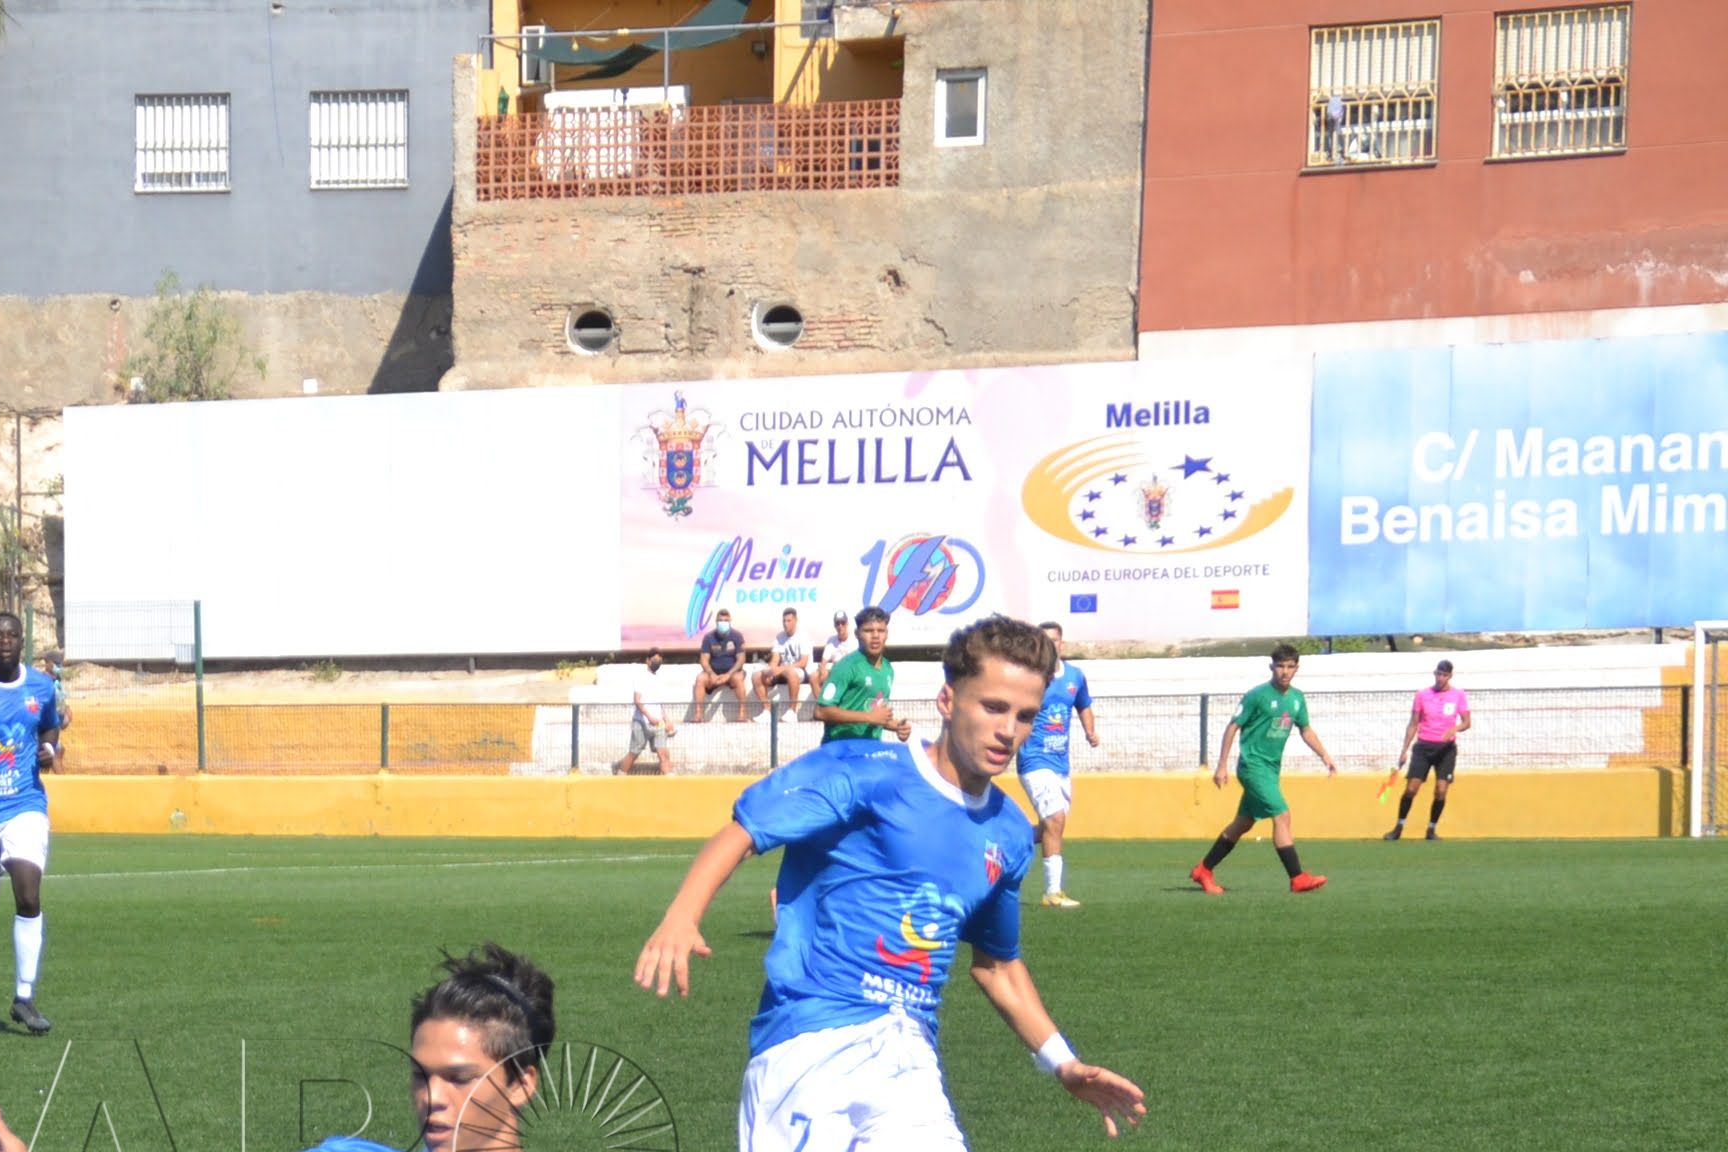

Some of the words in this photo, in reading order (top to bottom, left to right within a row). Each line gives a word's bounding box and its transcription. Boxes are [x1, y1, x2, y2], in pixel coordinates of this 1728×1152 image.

[739, 410, 823, 432] CIUDAD
[831, 402, 972, 429] AUTÓNOMA
[1105, 399, 1211, 429] Melilla
[761, 439, 775, 450] DE
[1412, 429, 1480, 483] C/
[1494, 427, 1728, 480] Maanan
[744, 435, 973, 487] MELILLA
[1340, 489, 1579, 546] Benaisa
[1600, 482, 1728, 536] Mim
[1047, 569, 1101, 583] CIUDAD
[1104, 567, 1169, 581] EUROPEA
[1174, 566, 1200, 579] DEL
[1204, 564, 1271, 578] DEPORTE
[735, 586, 817, 604] DEPORTE
